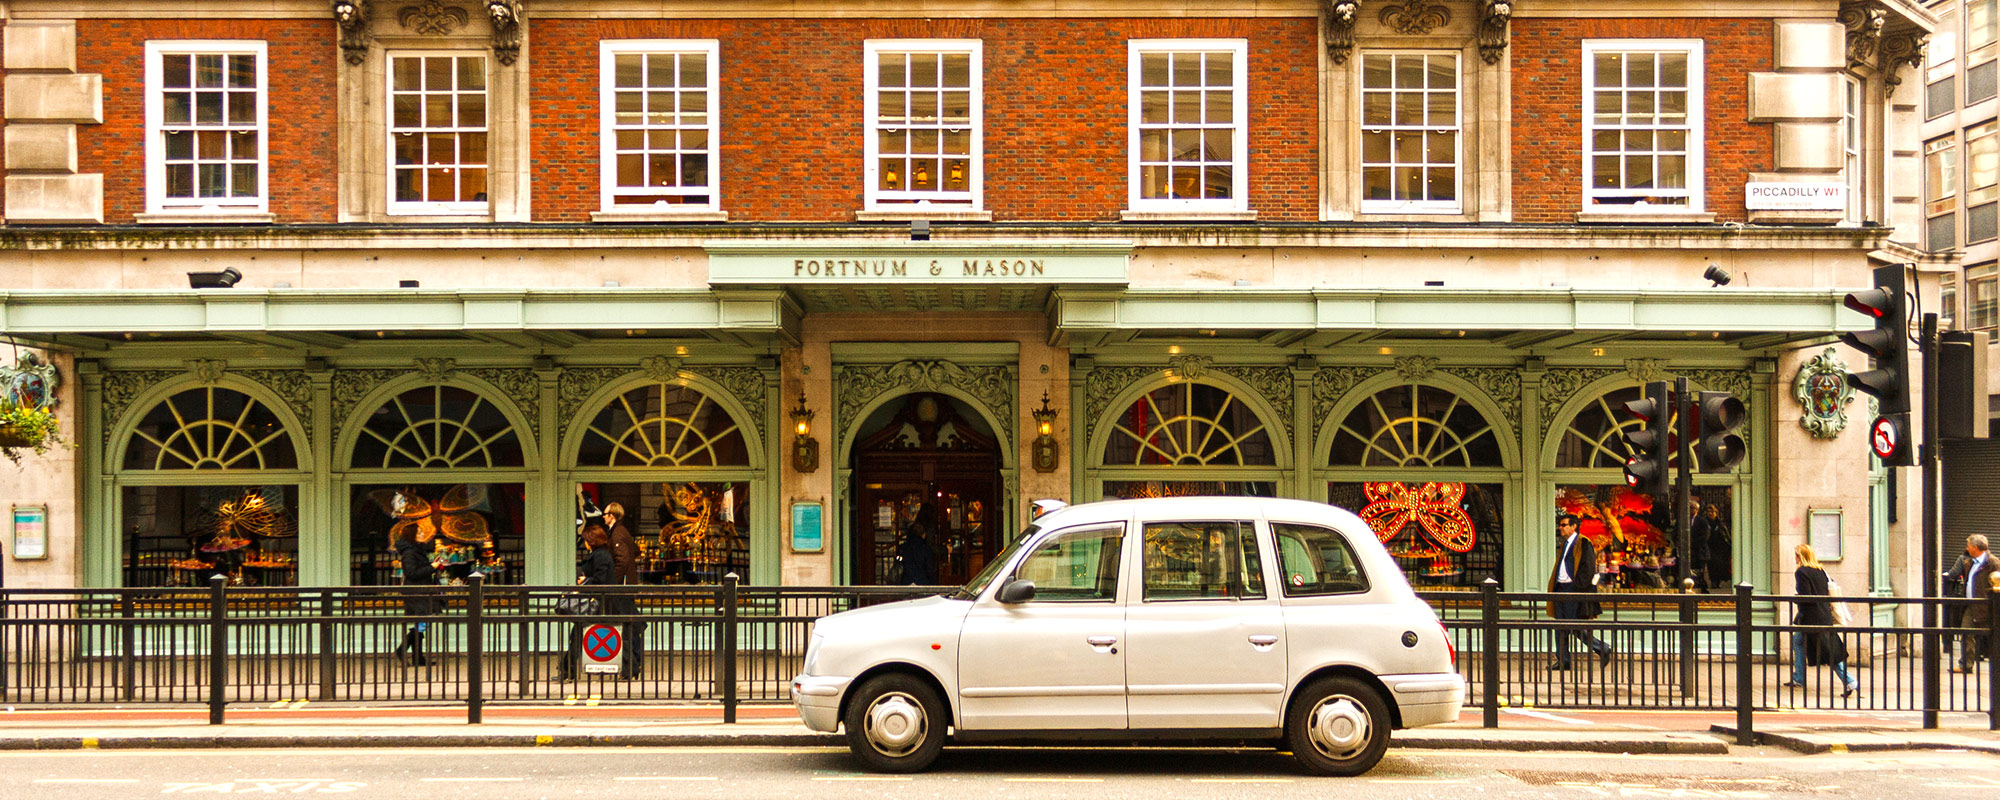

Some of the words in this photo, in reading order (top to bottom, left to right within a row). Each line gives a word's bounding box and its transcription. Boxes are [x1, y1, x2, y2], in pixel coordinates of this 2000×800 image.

[1752, 187, 1820, 197] PICCADILLY
[1823, 187, 1839, 197] W1
[793, 259, 908, 277] FORTNUM
[929, 259, 943, 277] &
[963, 259, 1046, 277] MASON
[159, 781, 369, 794] TAXIS
